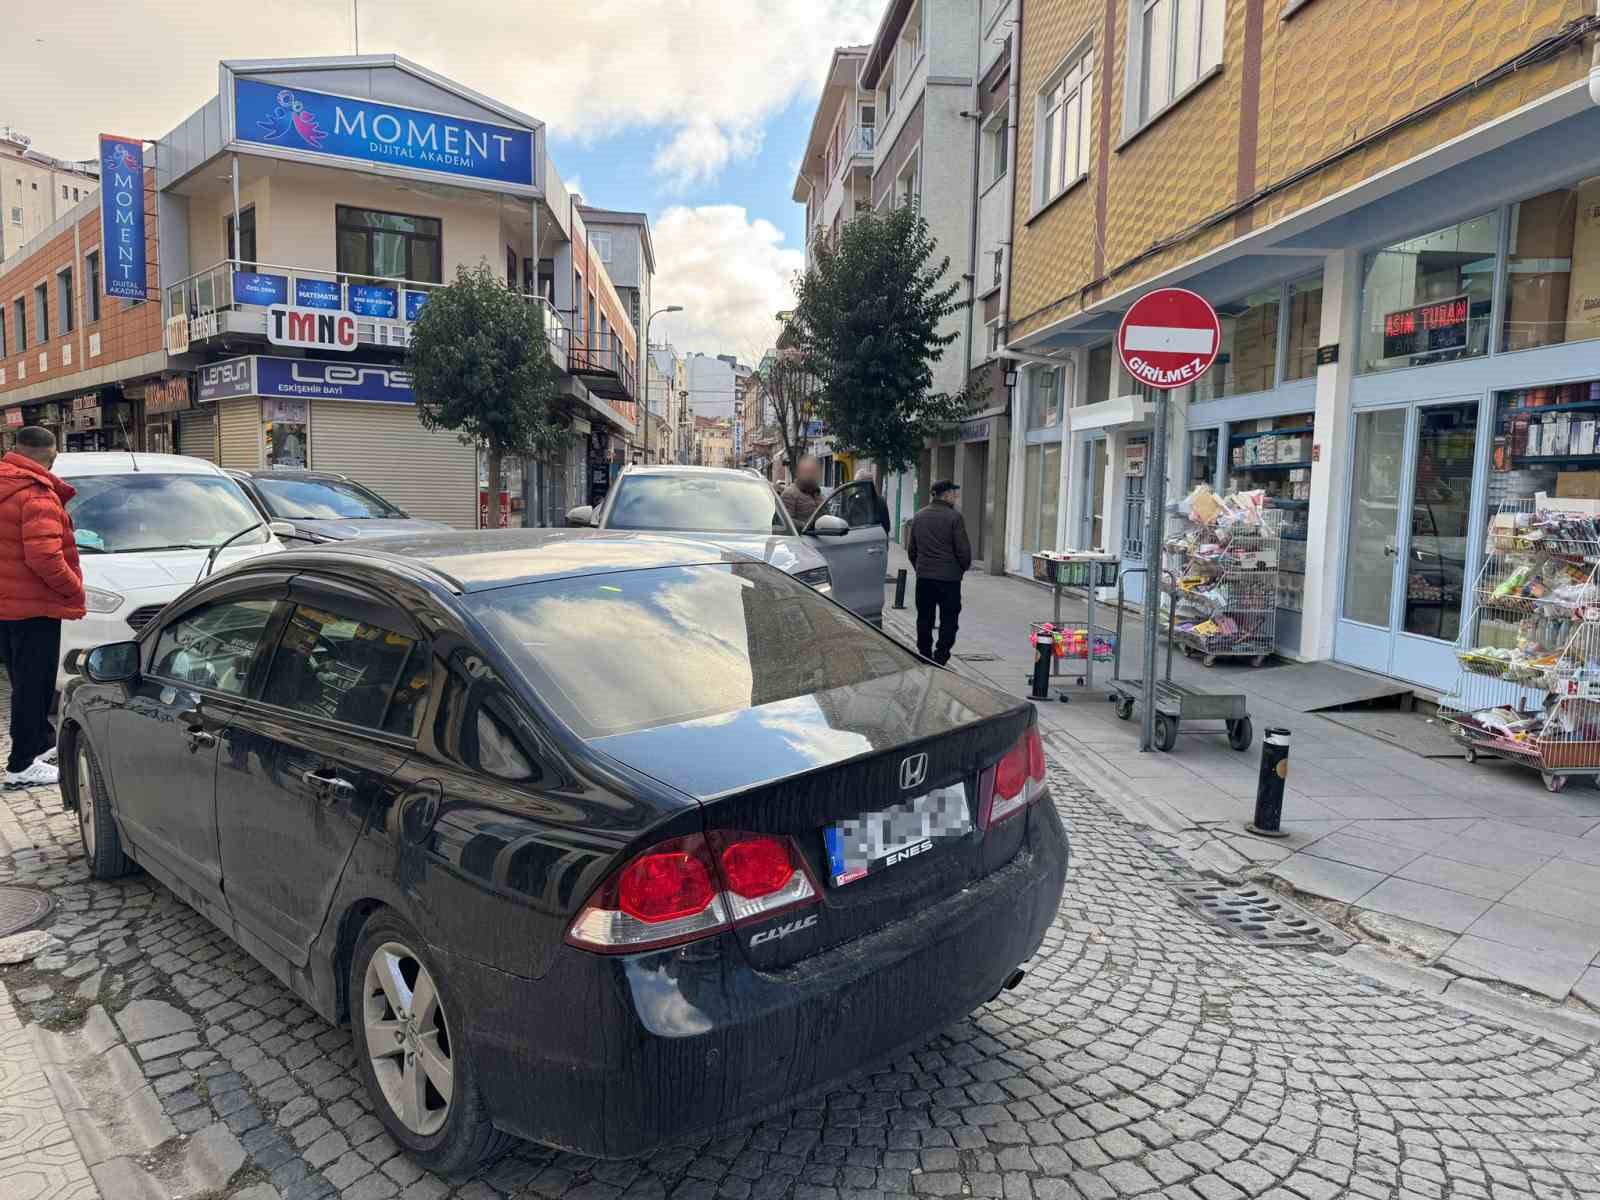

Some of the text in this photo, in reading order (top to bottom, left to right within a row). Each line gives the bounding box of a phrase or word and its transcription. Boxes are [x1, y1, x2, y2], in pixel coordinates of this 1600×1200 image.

[334, 106, 512, 162] MOMENT
[114, 172, 134, 279] MOMENT
[271, 310, 354, 346] TMNC
[1129, 357, 1205, 382] GİRİLMEZ
[886, 839, 933, 867] ENES
